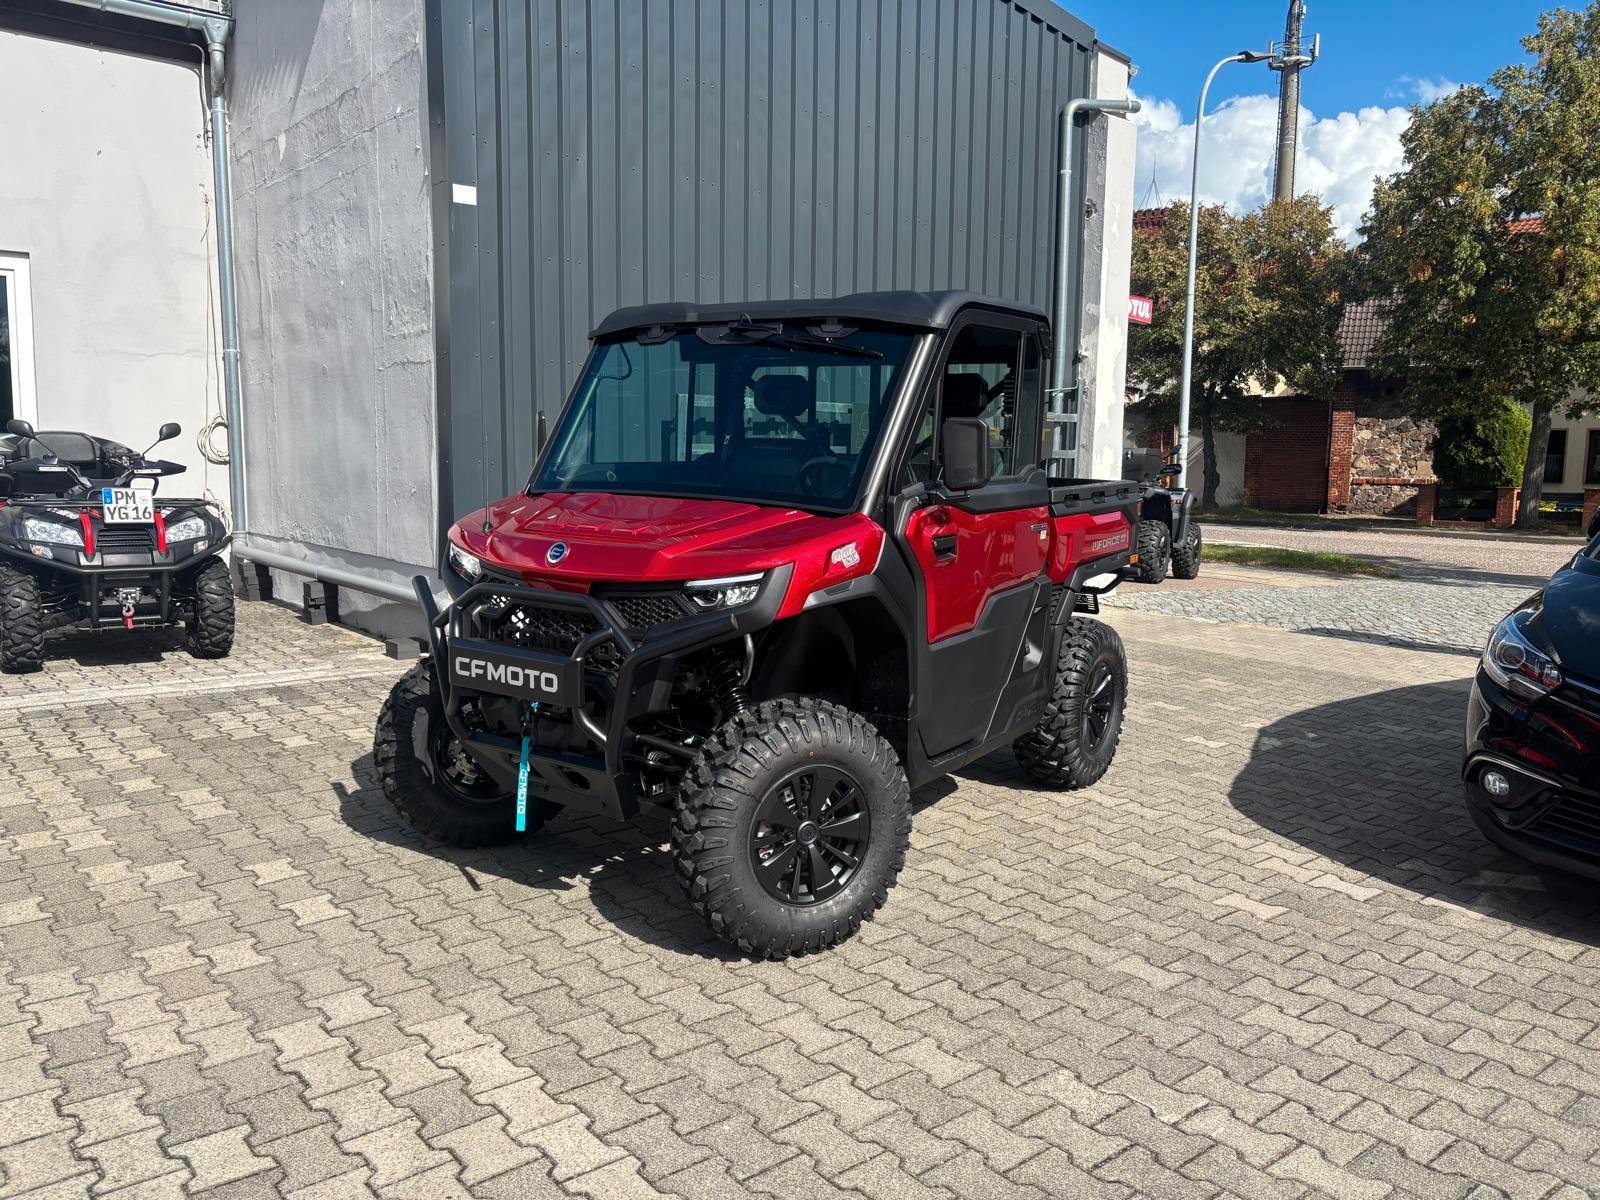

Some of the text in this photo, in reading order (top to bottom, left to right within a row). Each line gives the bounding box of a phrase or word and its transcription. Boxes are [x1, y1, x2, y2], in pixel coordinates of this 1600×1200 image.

[114, 491, 136, 504] PM
[107, 506, 129, 520] YG
[132, 506, 152, 520] 16
[455, 656, 558, 693] CFMOTO
